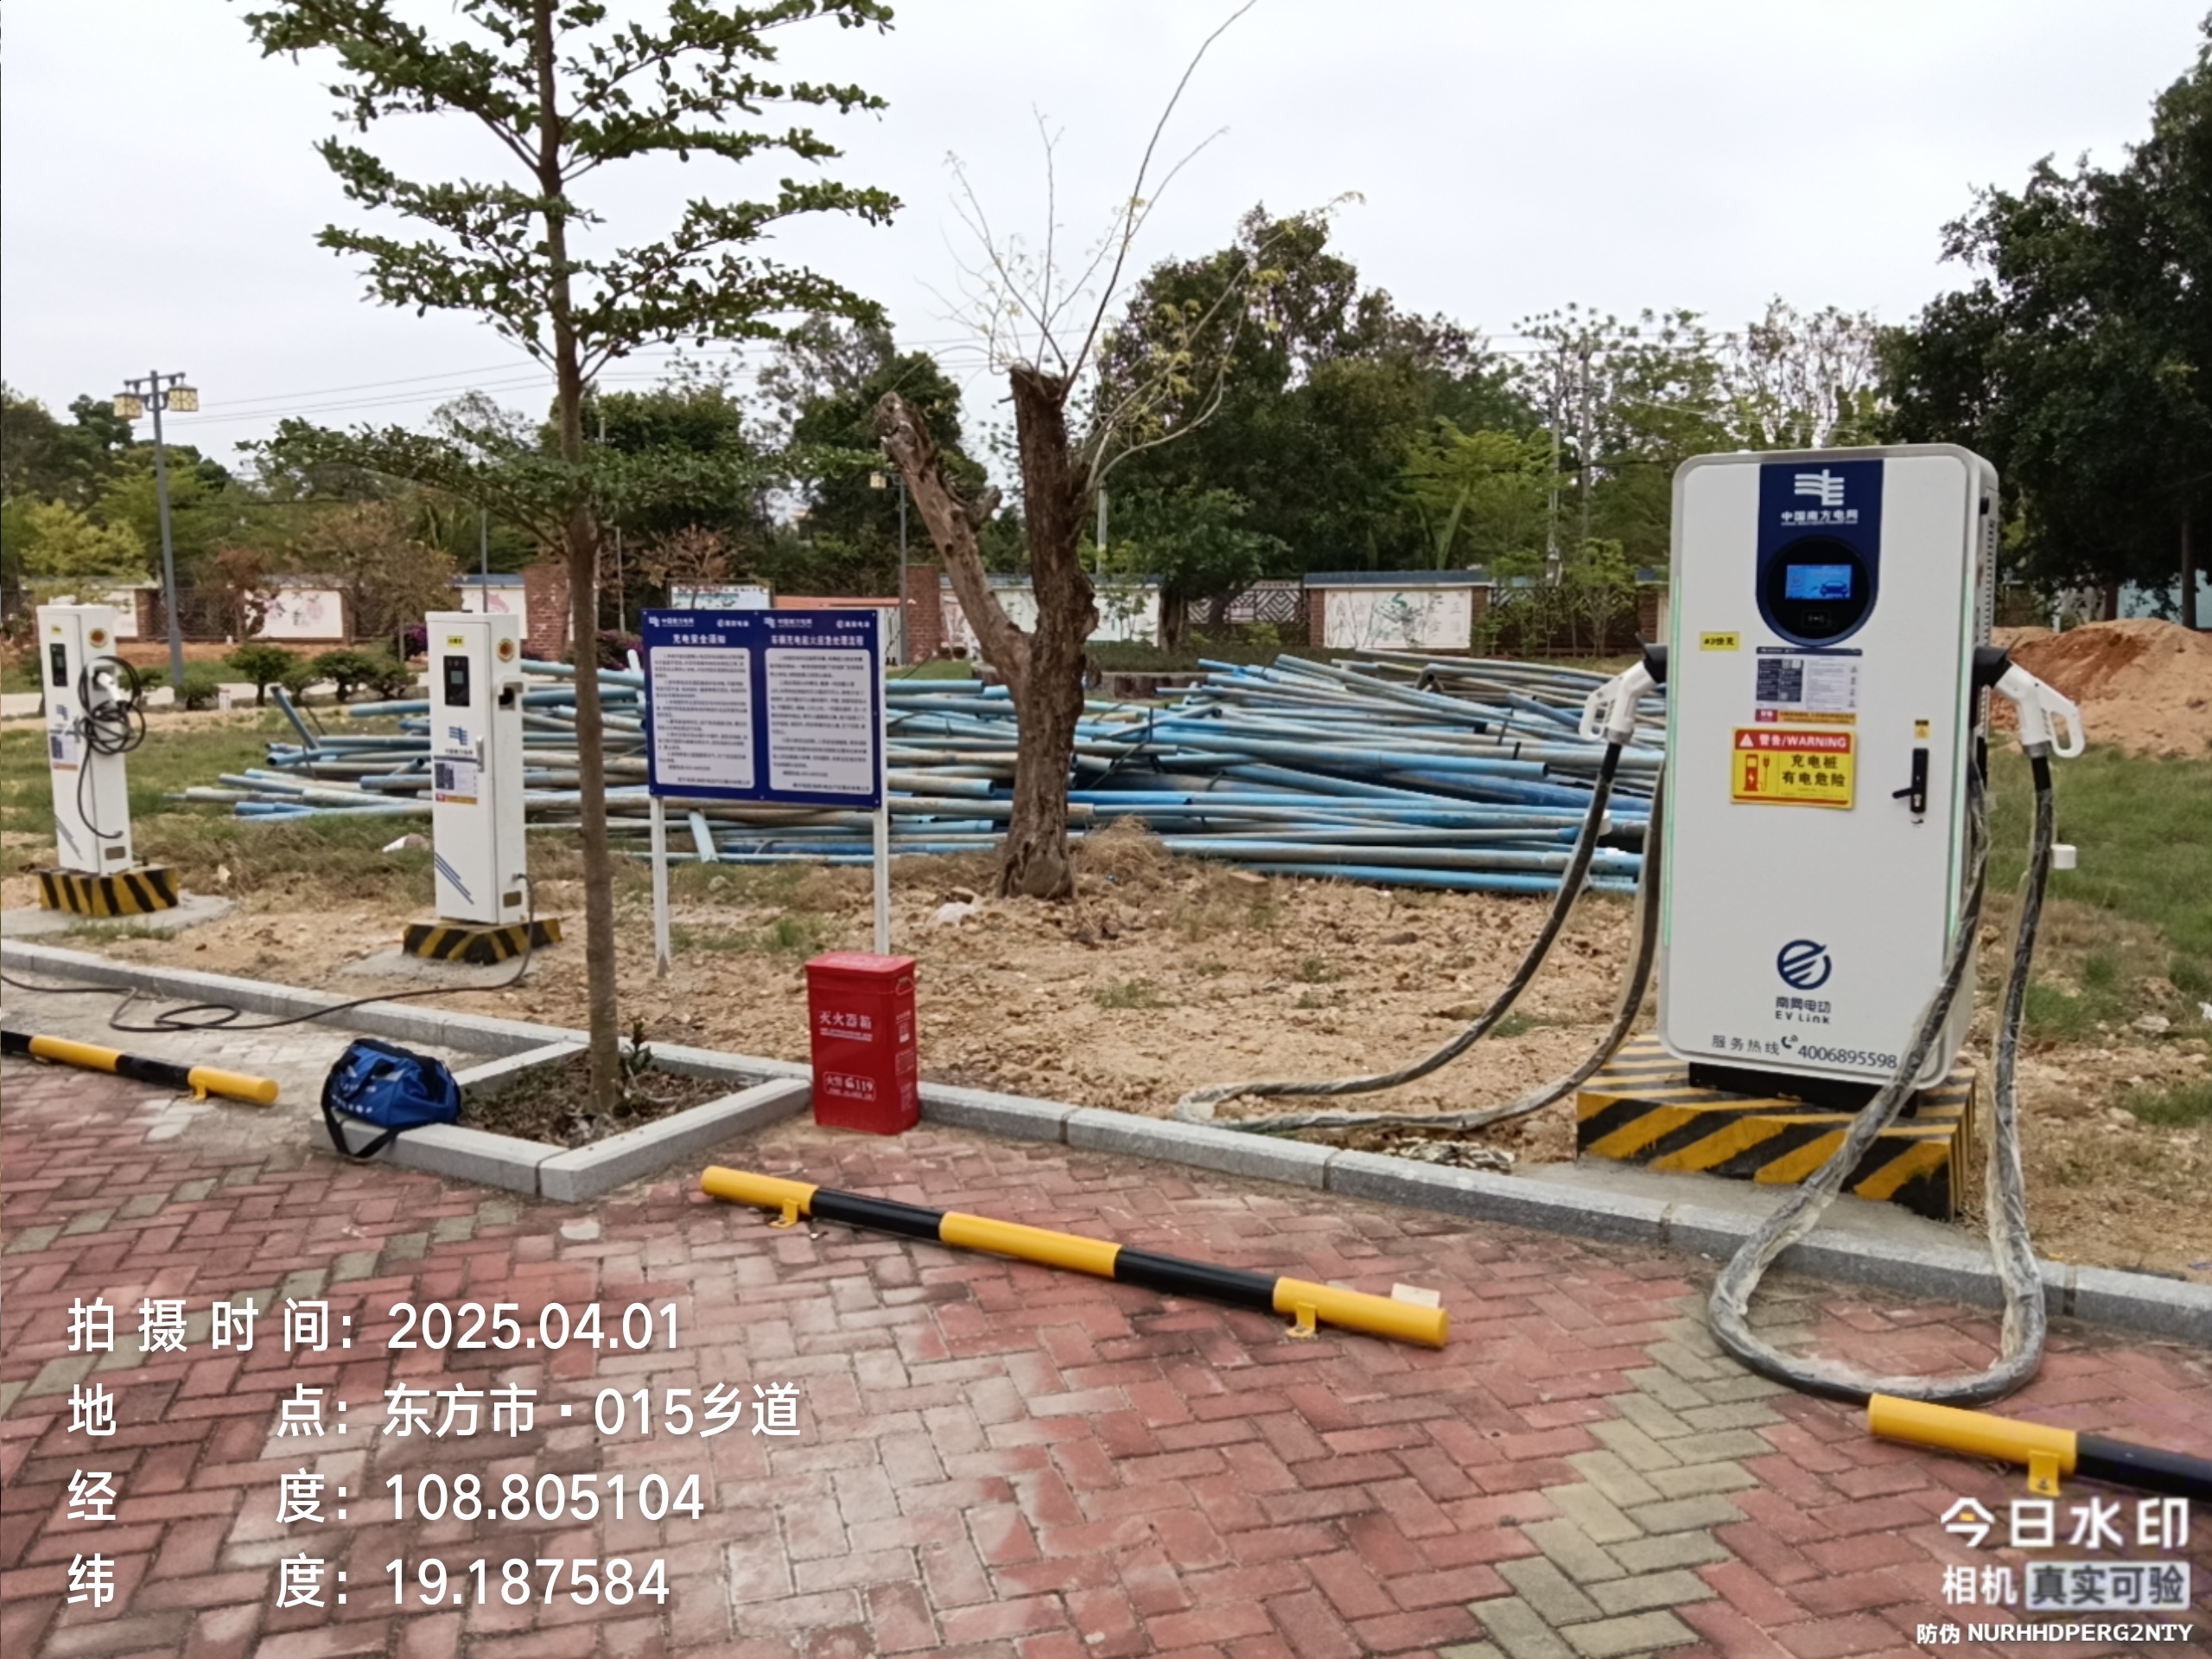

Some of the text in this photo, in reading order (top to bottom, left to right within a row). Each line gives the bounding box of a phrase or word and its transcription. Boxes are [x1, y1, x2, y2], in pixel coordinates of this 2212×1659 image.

[1781, 509, 1859, 522] 中国南方电网
[1791, 754, 1838, 769] 充电桩
[1782, 772, 1846, 787] 有电危险
[819, 1010, 872, 1030] 灭火器箱
[1712, 1034, 1897, 1069] 服务热线 4006895598
